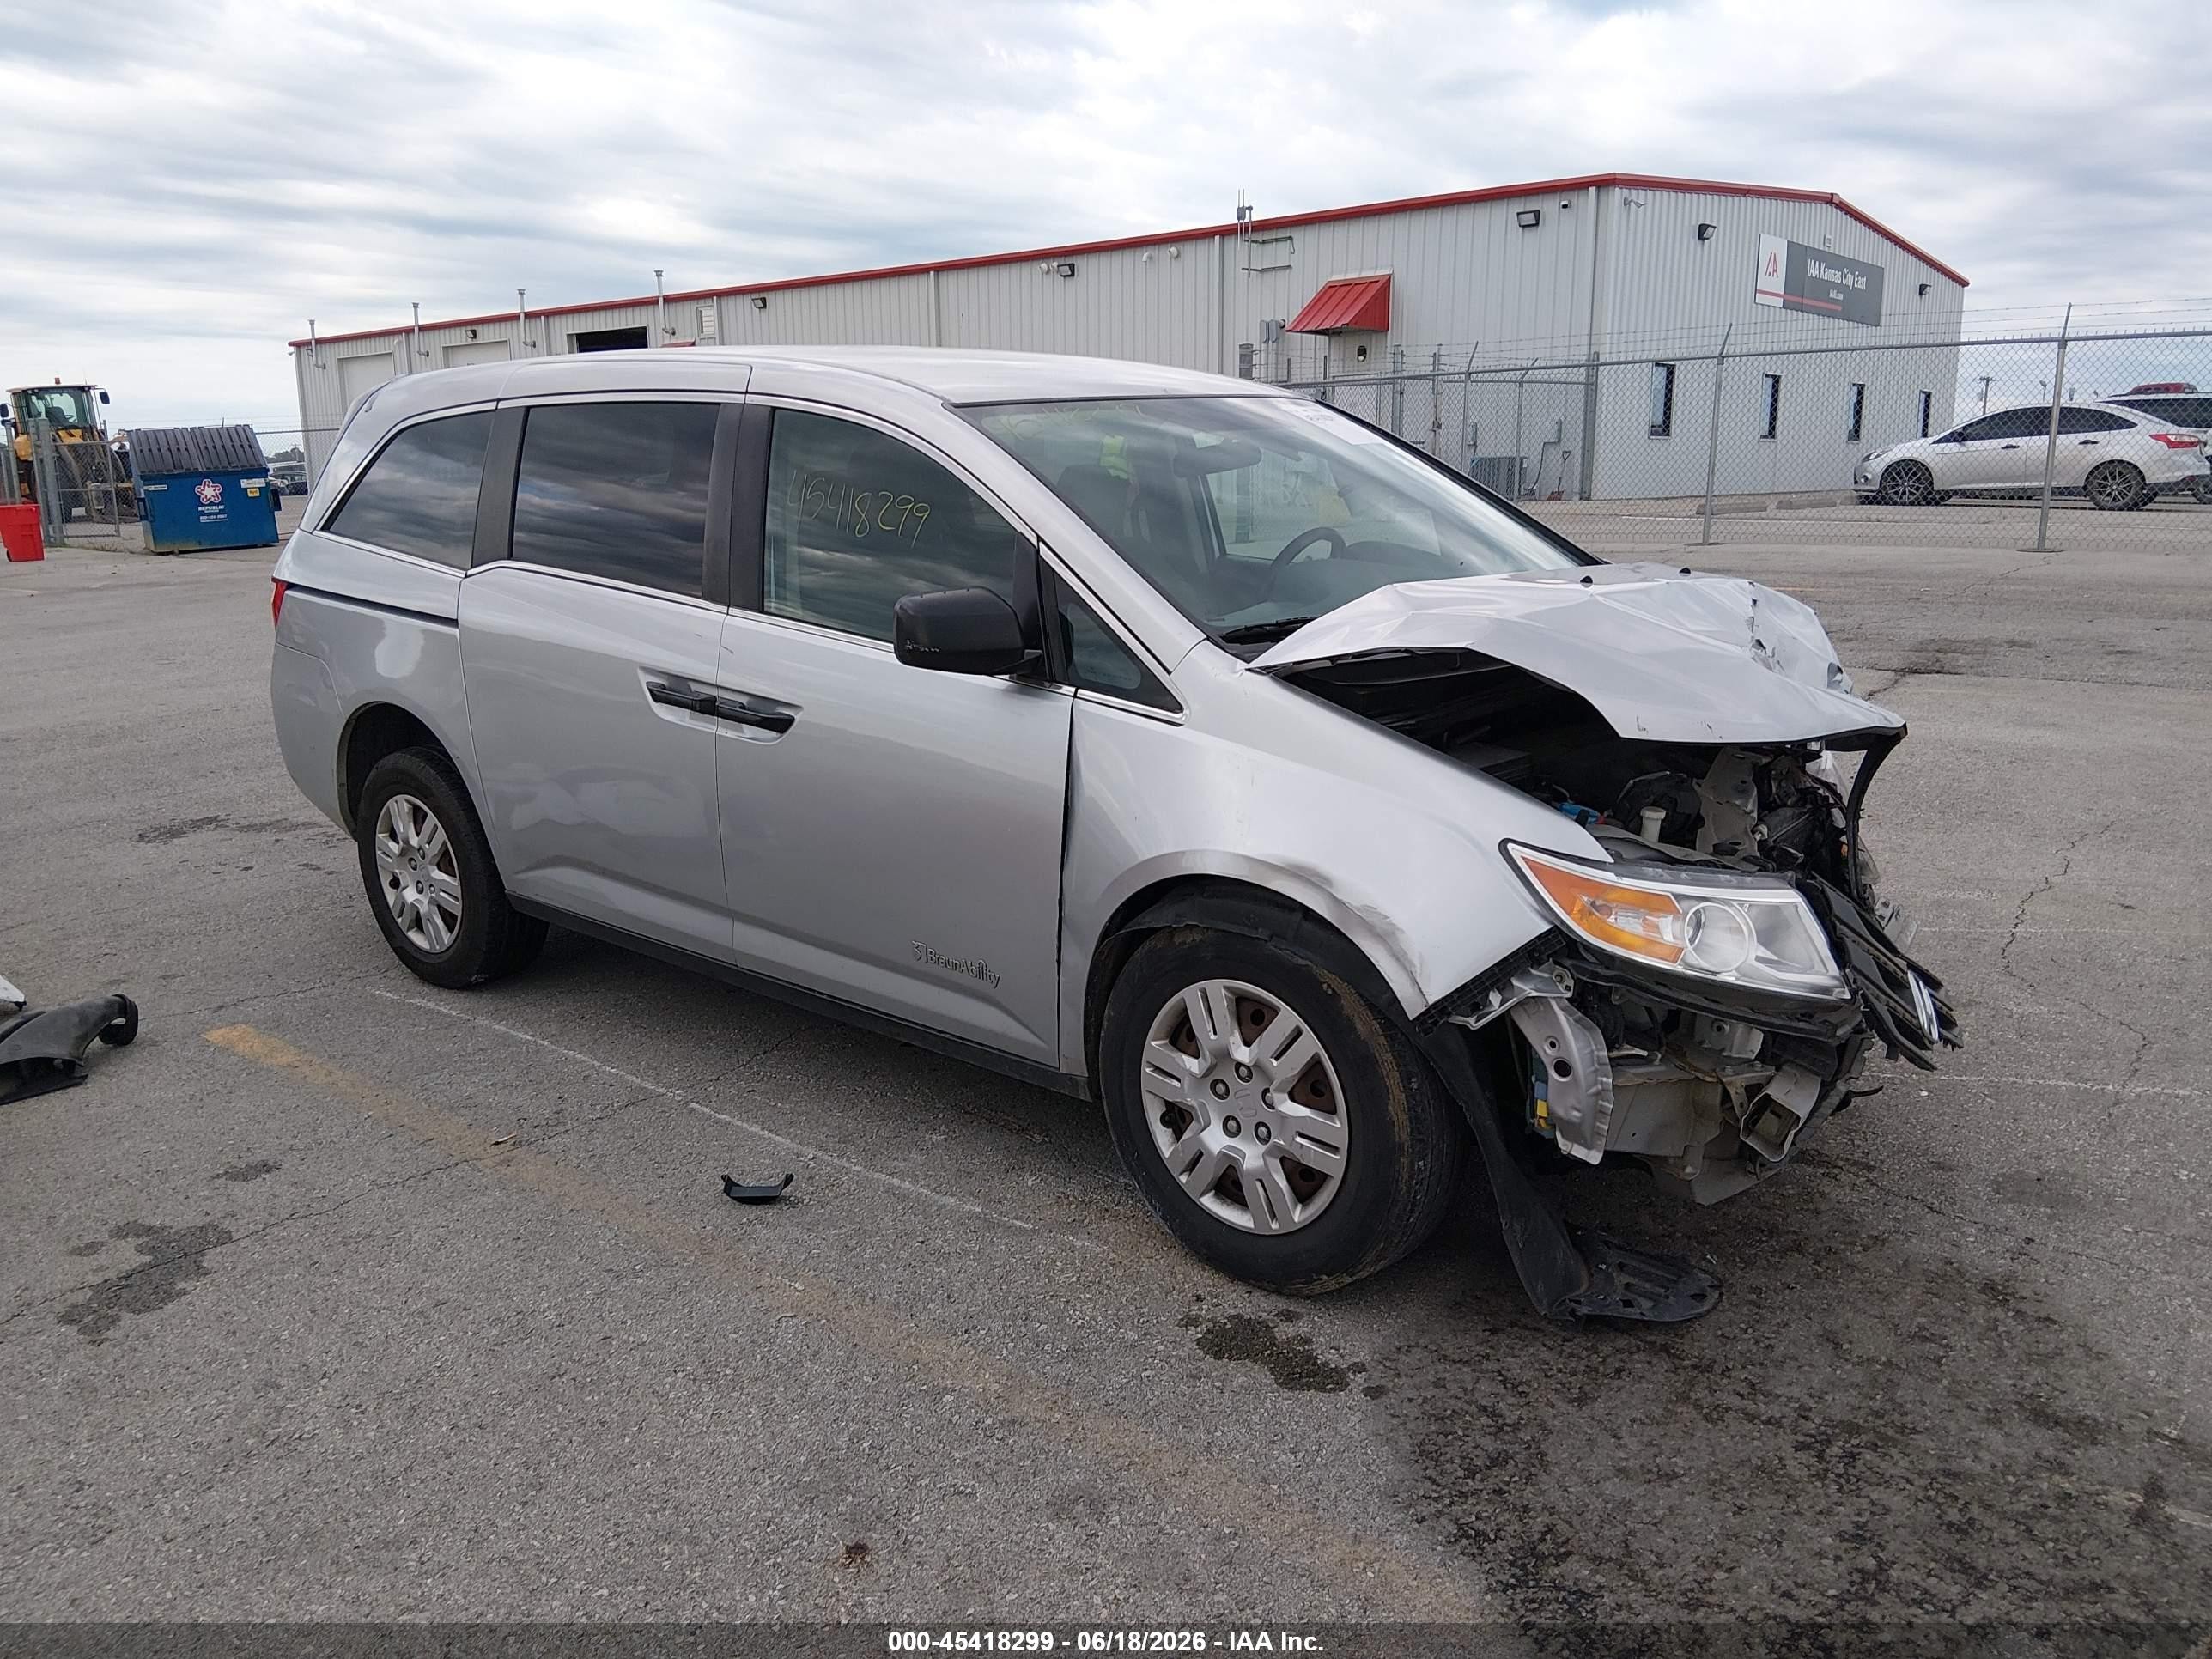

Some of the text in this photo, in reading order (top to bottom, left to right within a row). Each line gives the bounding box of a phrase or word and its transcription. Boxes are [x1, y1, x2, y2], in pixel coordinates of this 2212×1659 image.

[1808, 258, 1867, 290] IAA Kansas City East
[787, 469, 931, 549] 45418299
[927, 948, 1001, 989] BraunAbility
